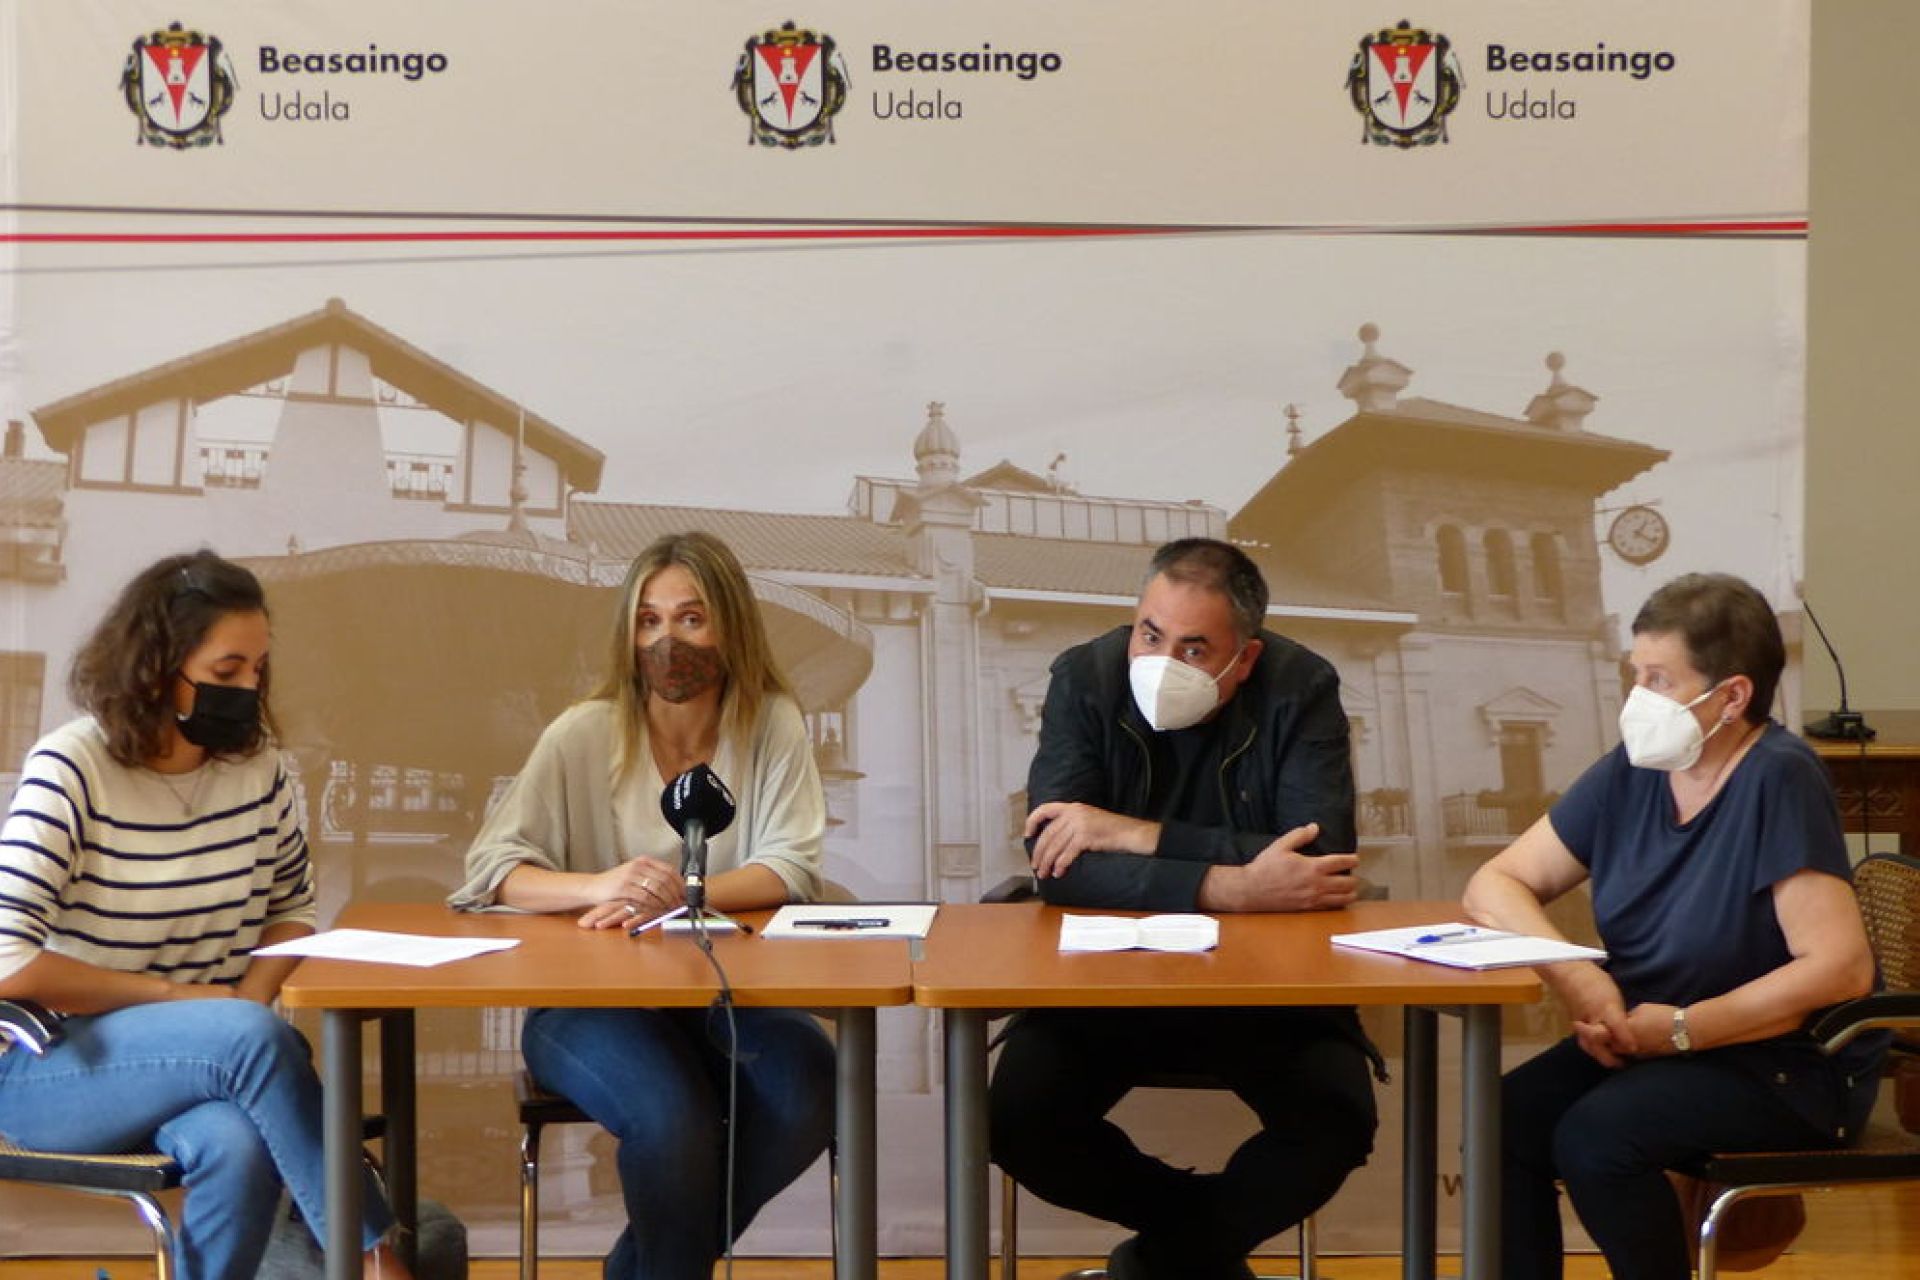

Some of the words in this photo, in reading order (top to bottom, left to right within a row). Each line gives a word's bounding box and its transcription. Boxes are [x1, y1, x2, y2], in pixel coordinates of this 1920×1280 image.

[258, 43, 449, 81] Beasaingo
[872, 42, 1062, 81] Beasaingo
[1486, 41, 1675, 80] Beasaingo
[260, 90, 350, 121] Udala
[872, 89, 963, 121] Udala
[1486, 88, 1576, 121] Udala
